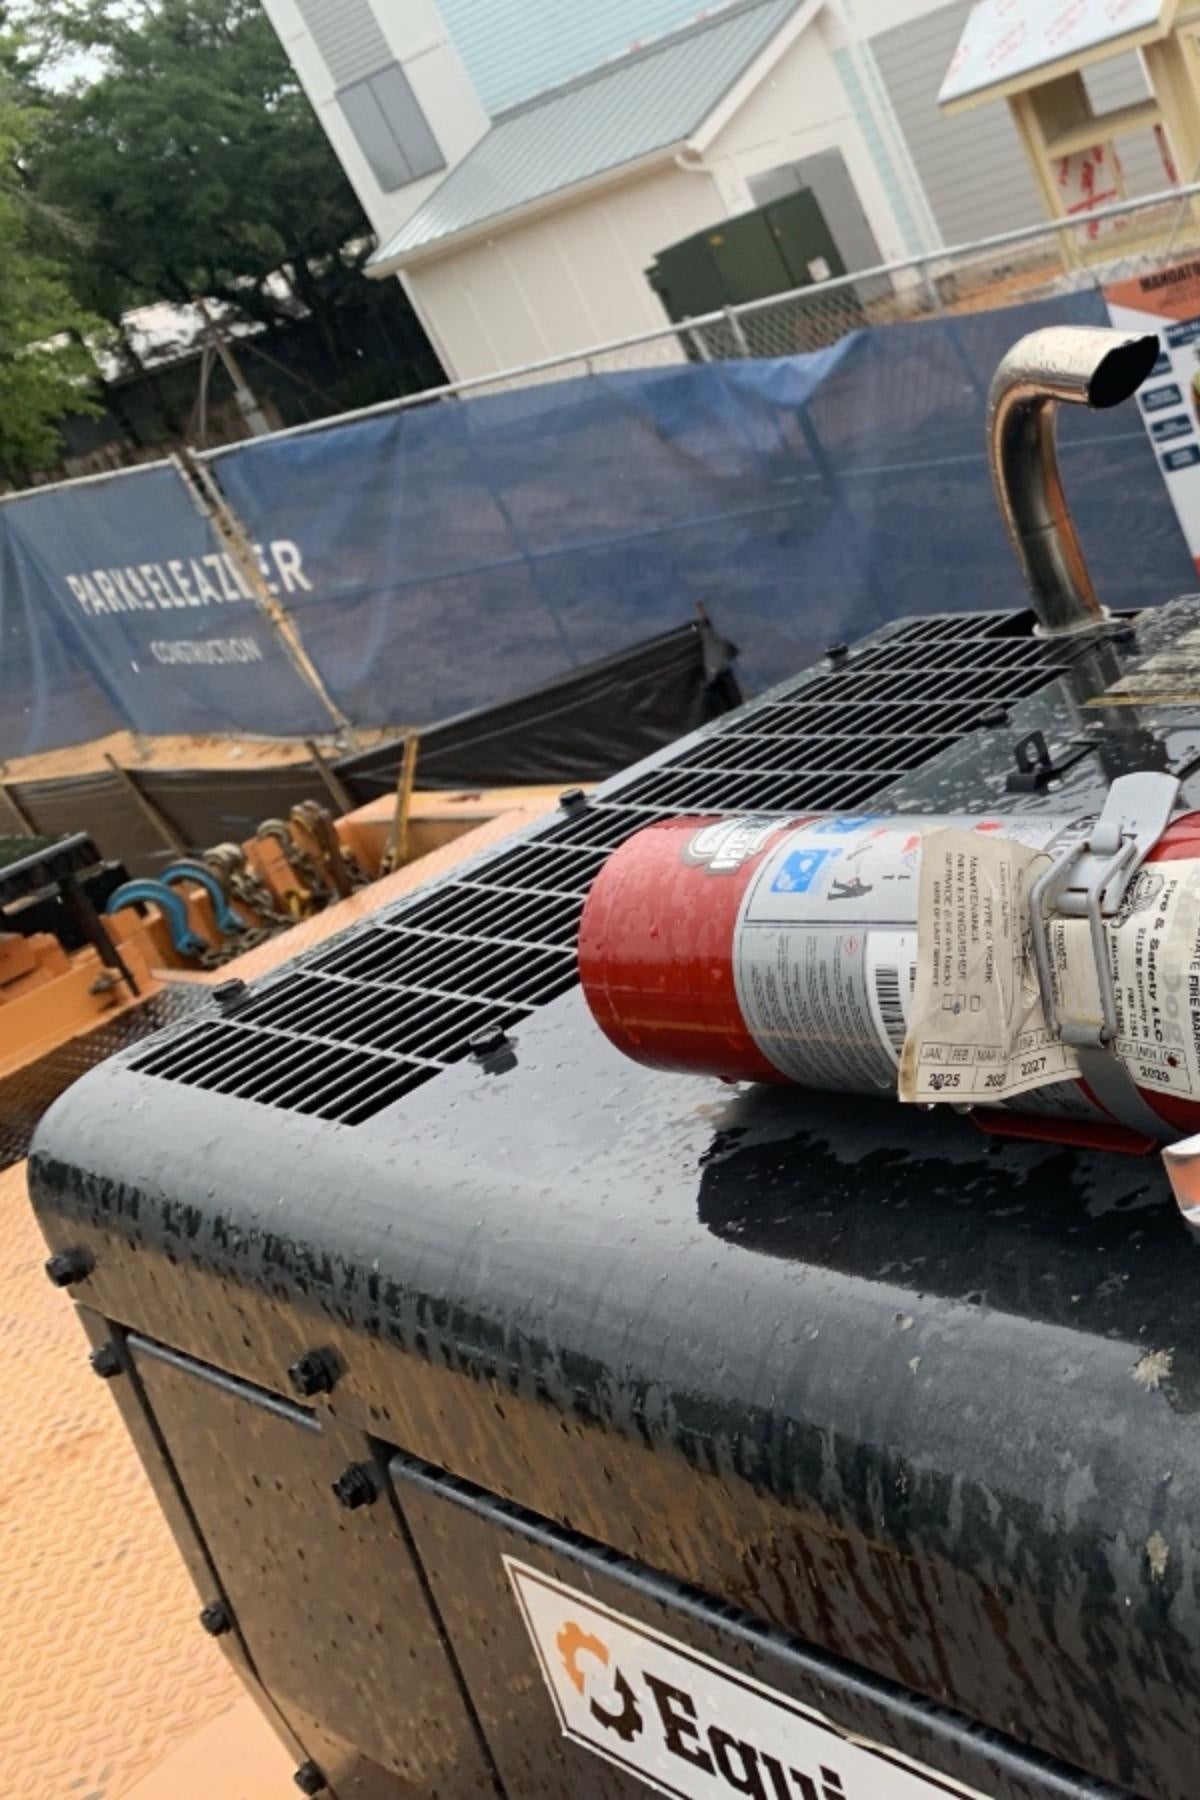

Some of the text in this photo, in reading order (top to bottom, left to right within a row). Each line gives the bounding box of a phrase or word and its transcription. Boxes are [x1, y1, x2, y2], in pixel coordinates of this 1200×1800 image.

[1188, 974, 1200, 1007] FIRE
[928, 1073, 961, 1088] 2025
[1021, 1056, 1047, 1077] 2027
